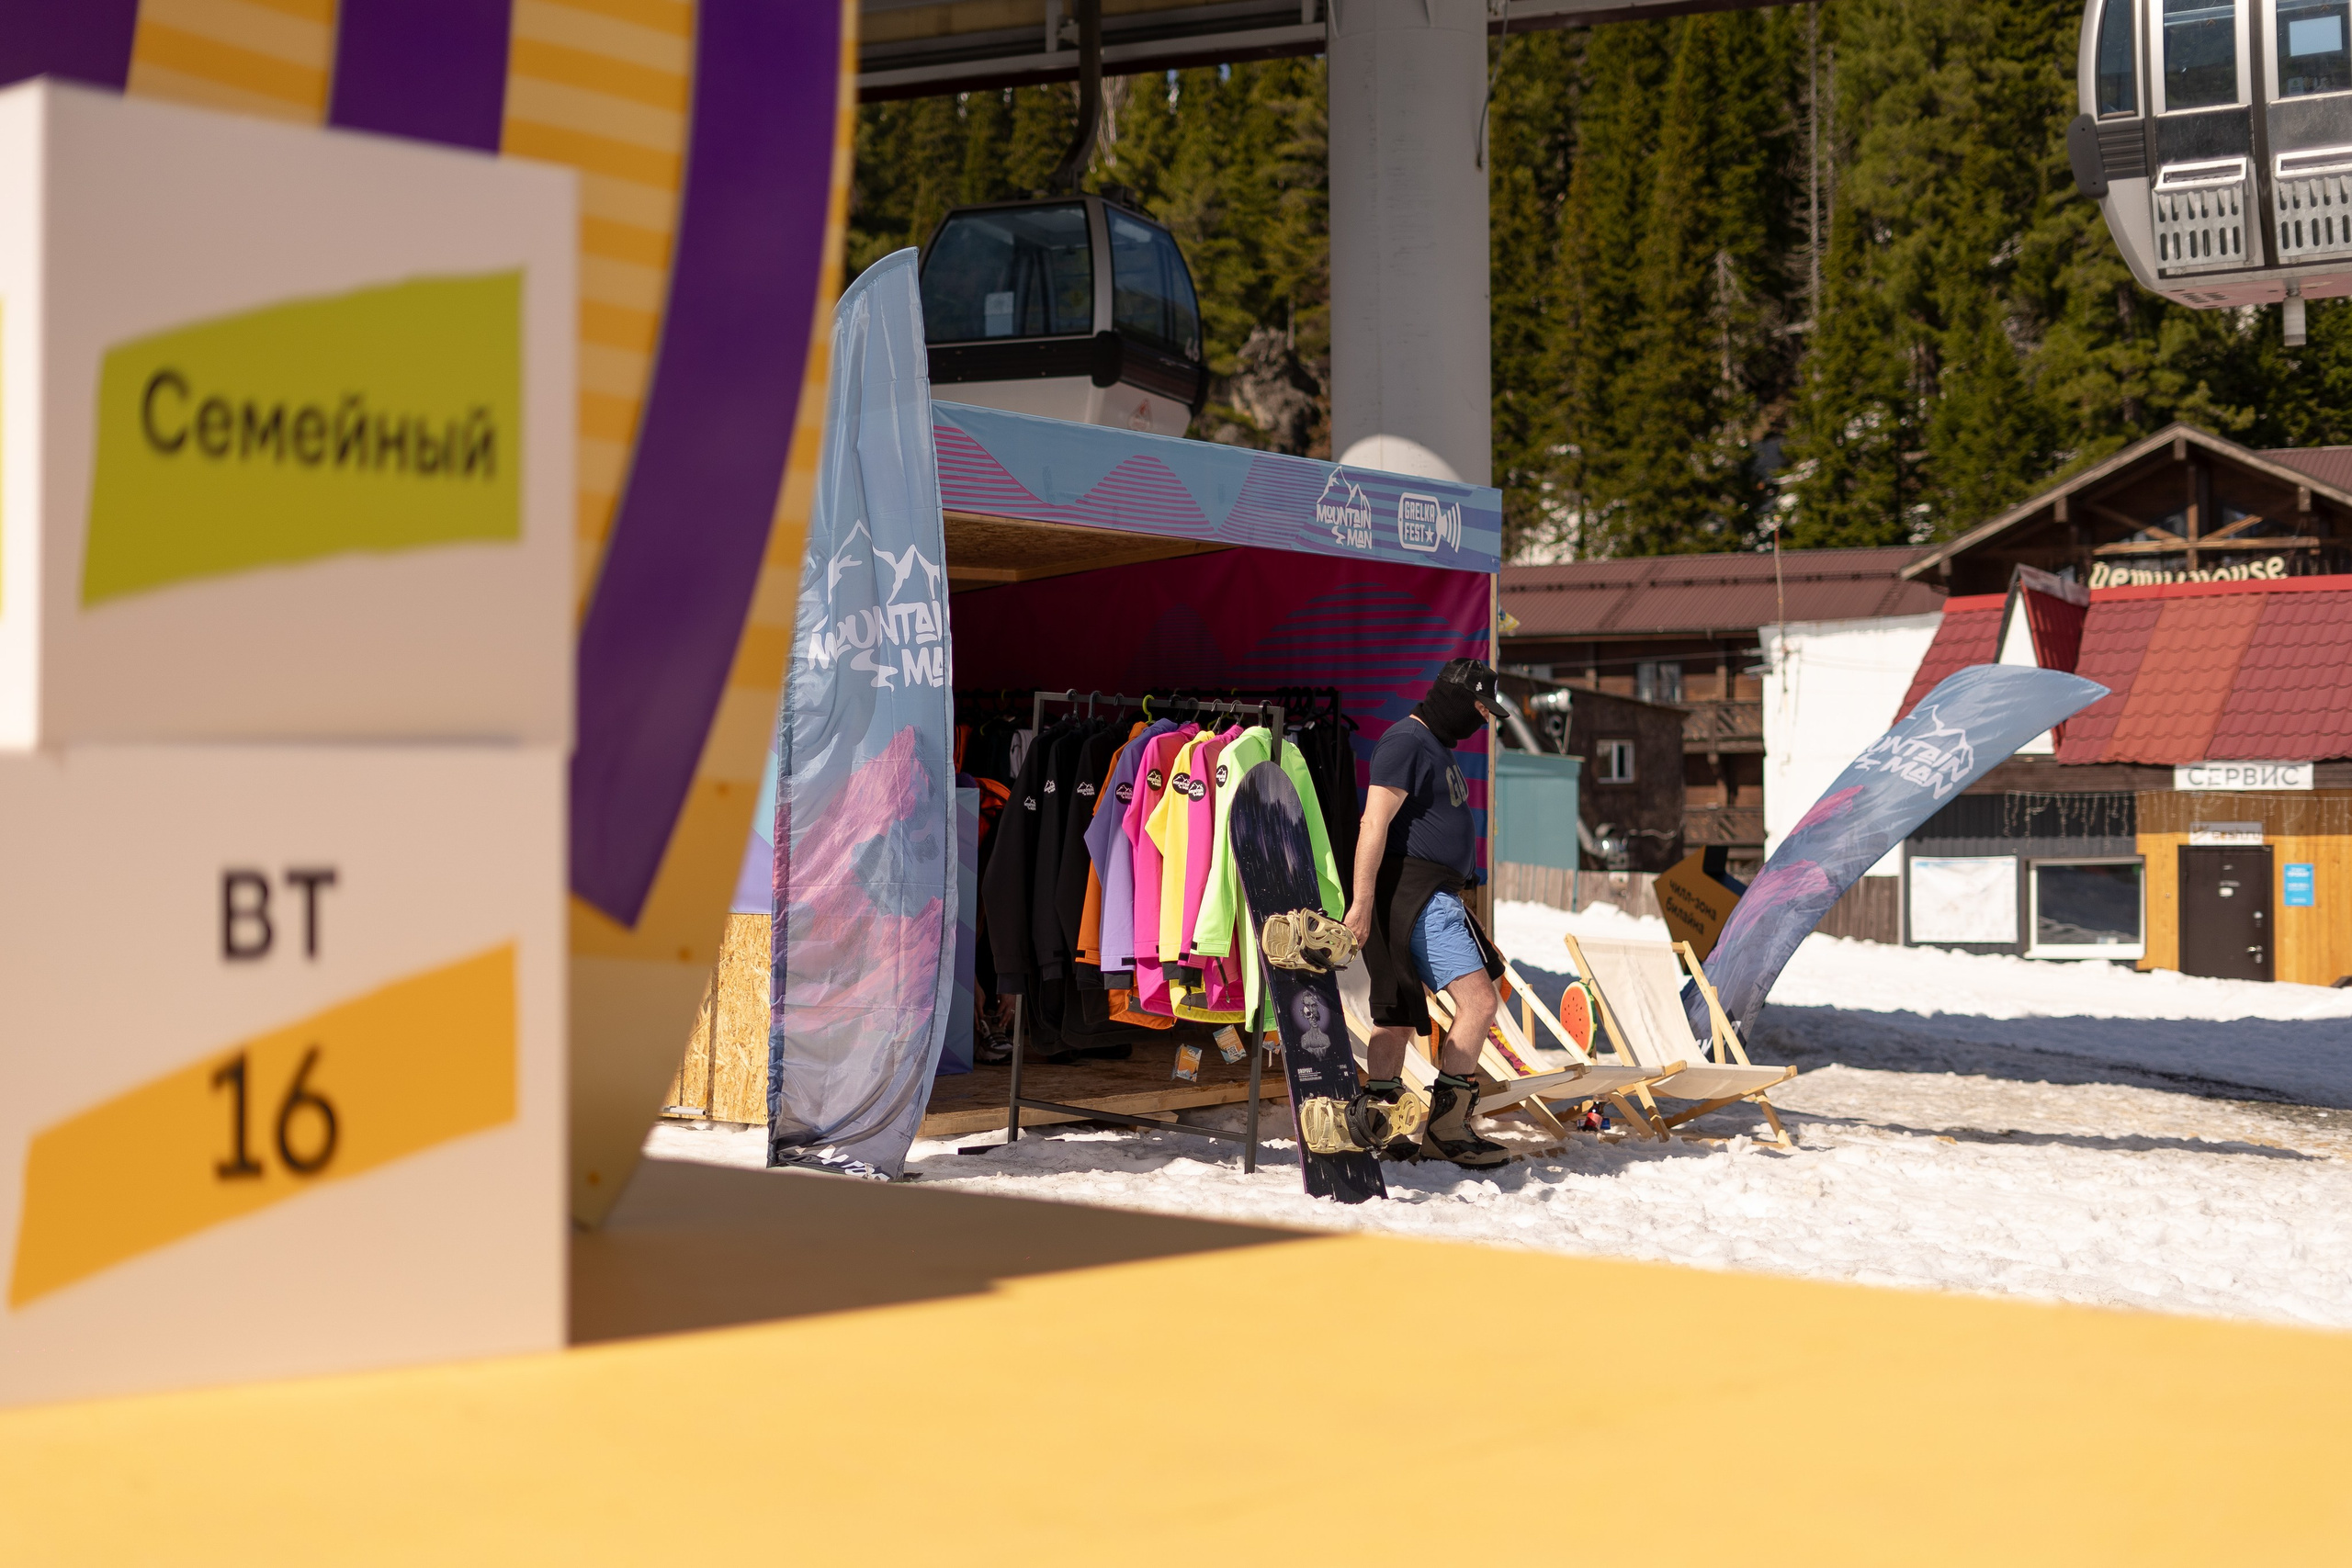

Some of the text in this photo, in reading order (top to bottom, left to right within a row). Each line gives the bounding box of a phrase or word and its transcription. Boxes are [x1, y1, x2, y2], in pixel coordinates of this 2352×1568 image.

[140, 365, 497, 480] Семейный
[1317, 503, 1372, 530] MOUNTAIN
[1405, 501, 1435, 523] GRELKA
[1347, 530, 1373, 549] MAN
[1405, 523, 1425, 542] FEST
[901, 646, 953, 688] MA
[1880, 756, 1953, 800] MAN
[2188, 766, 2299, 785] СЕРВИС
[220, 866, 338, 962] ВТ
[210, 1043, 339, 1181] 16
